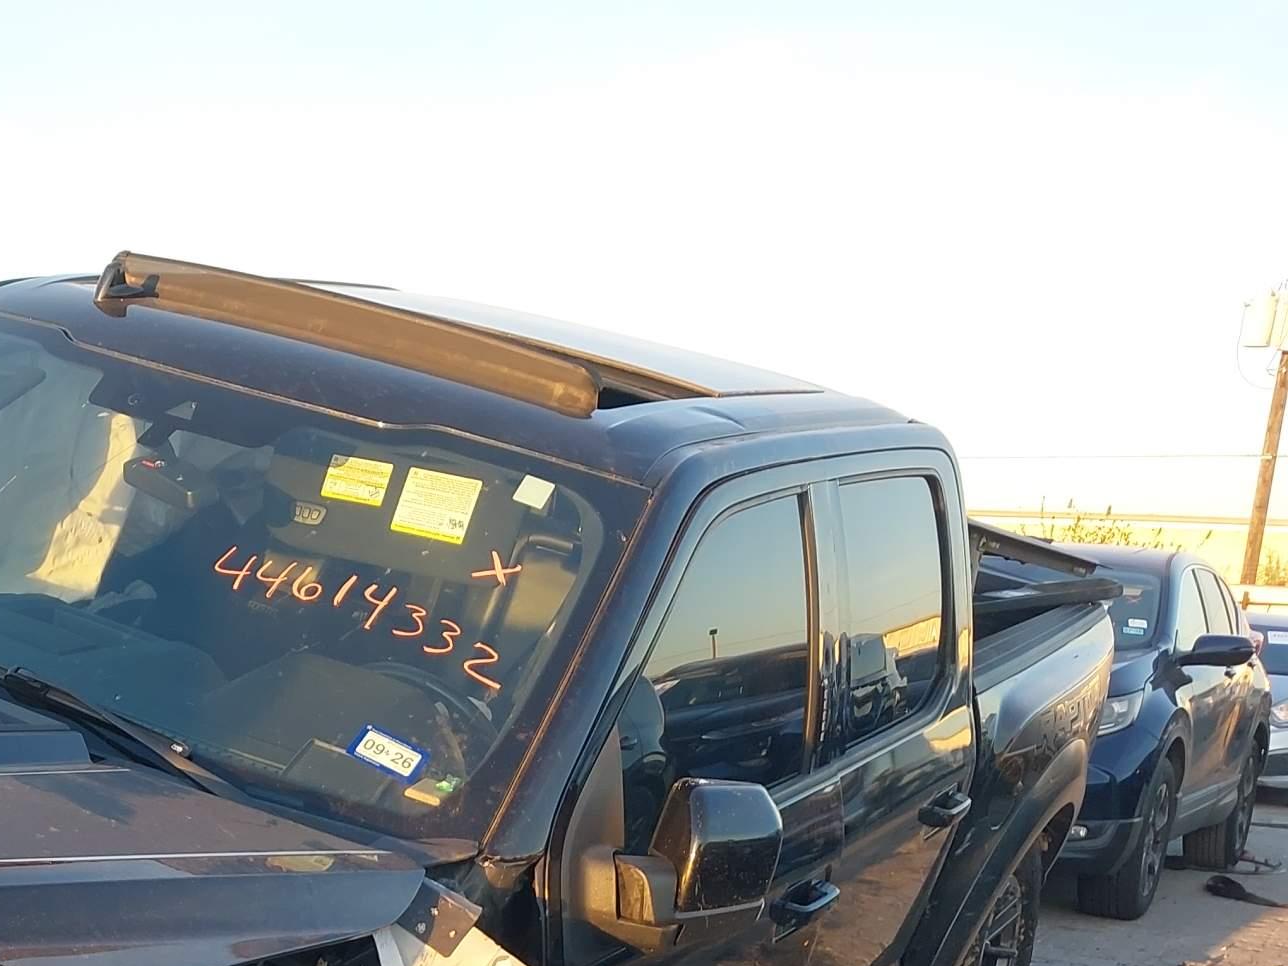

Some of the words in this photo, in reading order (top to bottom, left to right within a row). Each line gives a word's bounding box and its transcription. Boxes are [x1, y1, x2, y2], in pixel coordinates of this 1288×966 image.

[214, 545, 502, 690] 44614332
[363, 739, 386, 755] 09
[390, 752, 414, 769] 26
